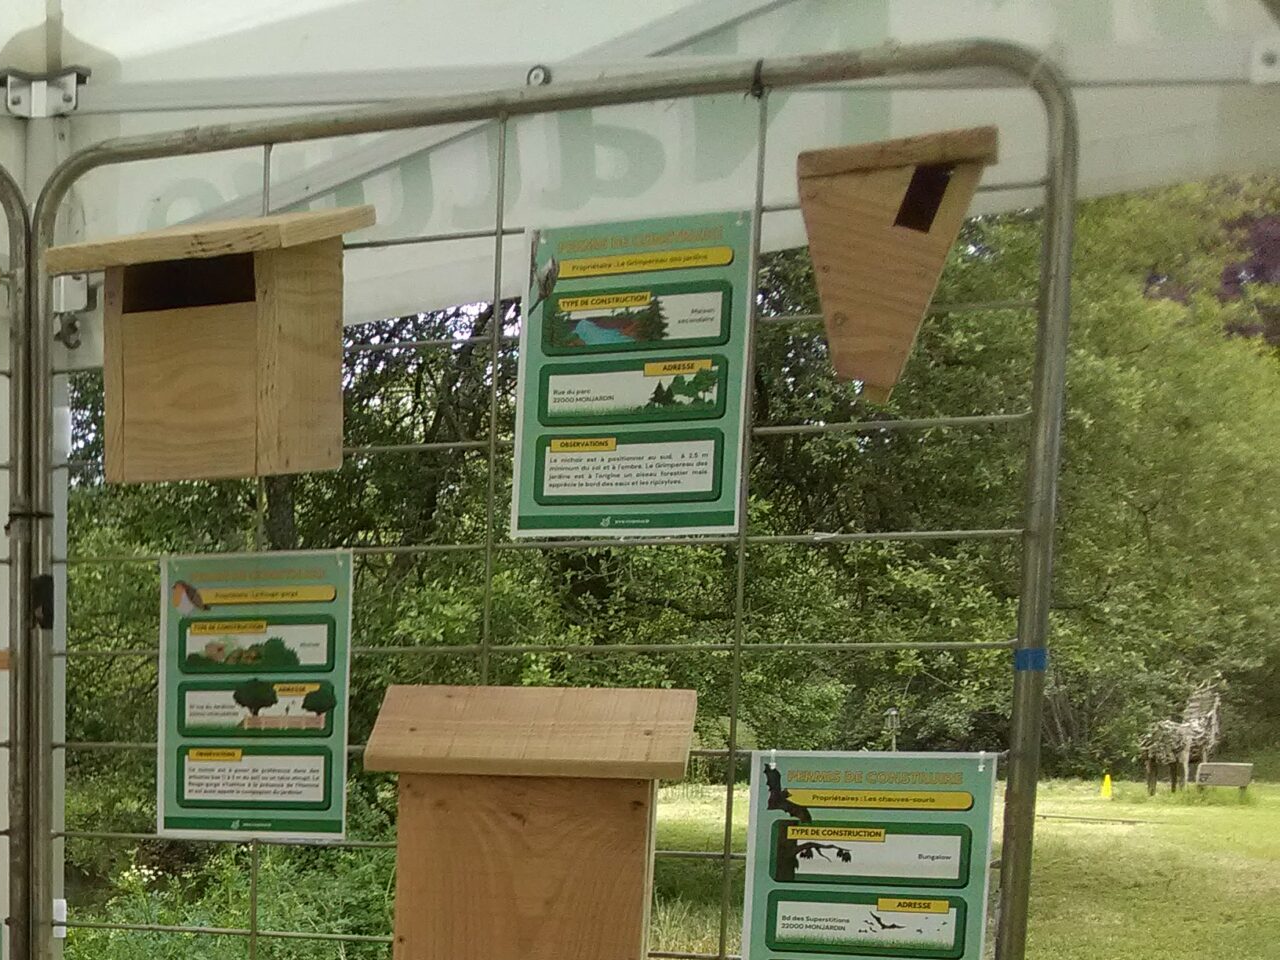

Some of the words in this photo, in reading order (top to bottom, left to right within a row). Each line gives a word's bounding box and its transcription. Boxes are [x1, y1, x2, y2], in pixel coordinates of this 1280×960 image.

[559, 297, 579, 309] TYPE
[579, 296, 589, 306] DE
[589, 294, 647, 305] CONSTRUCTION
[661, 362, 695, 371] ADRESSE
[559, 439, 609, 448] OBSERVATIONS
[786, 768, 840, 783] PERMIS
[843, 769, 862, 783] DE
[866, 769, 963, 785] CONSTRUIRE
[790, 827, 809, 836] TYPE
[809, 828, 820, 836] DE
[820, 828, 882, 837] CONSTRUCTION
[917, 853, 952, 861] Bungalow
[896, 900, 931, 909] ADRESSE
